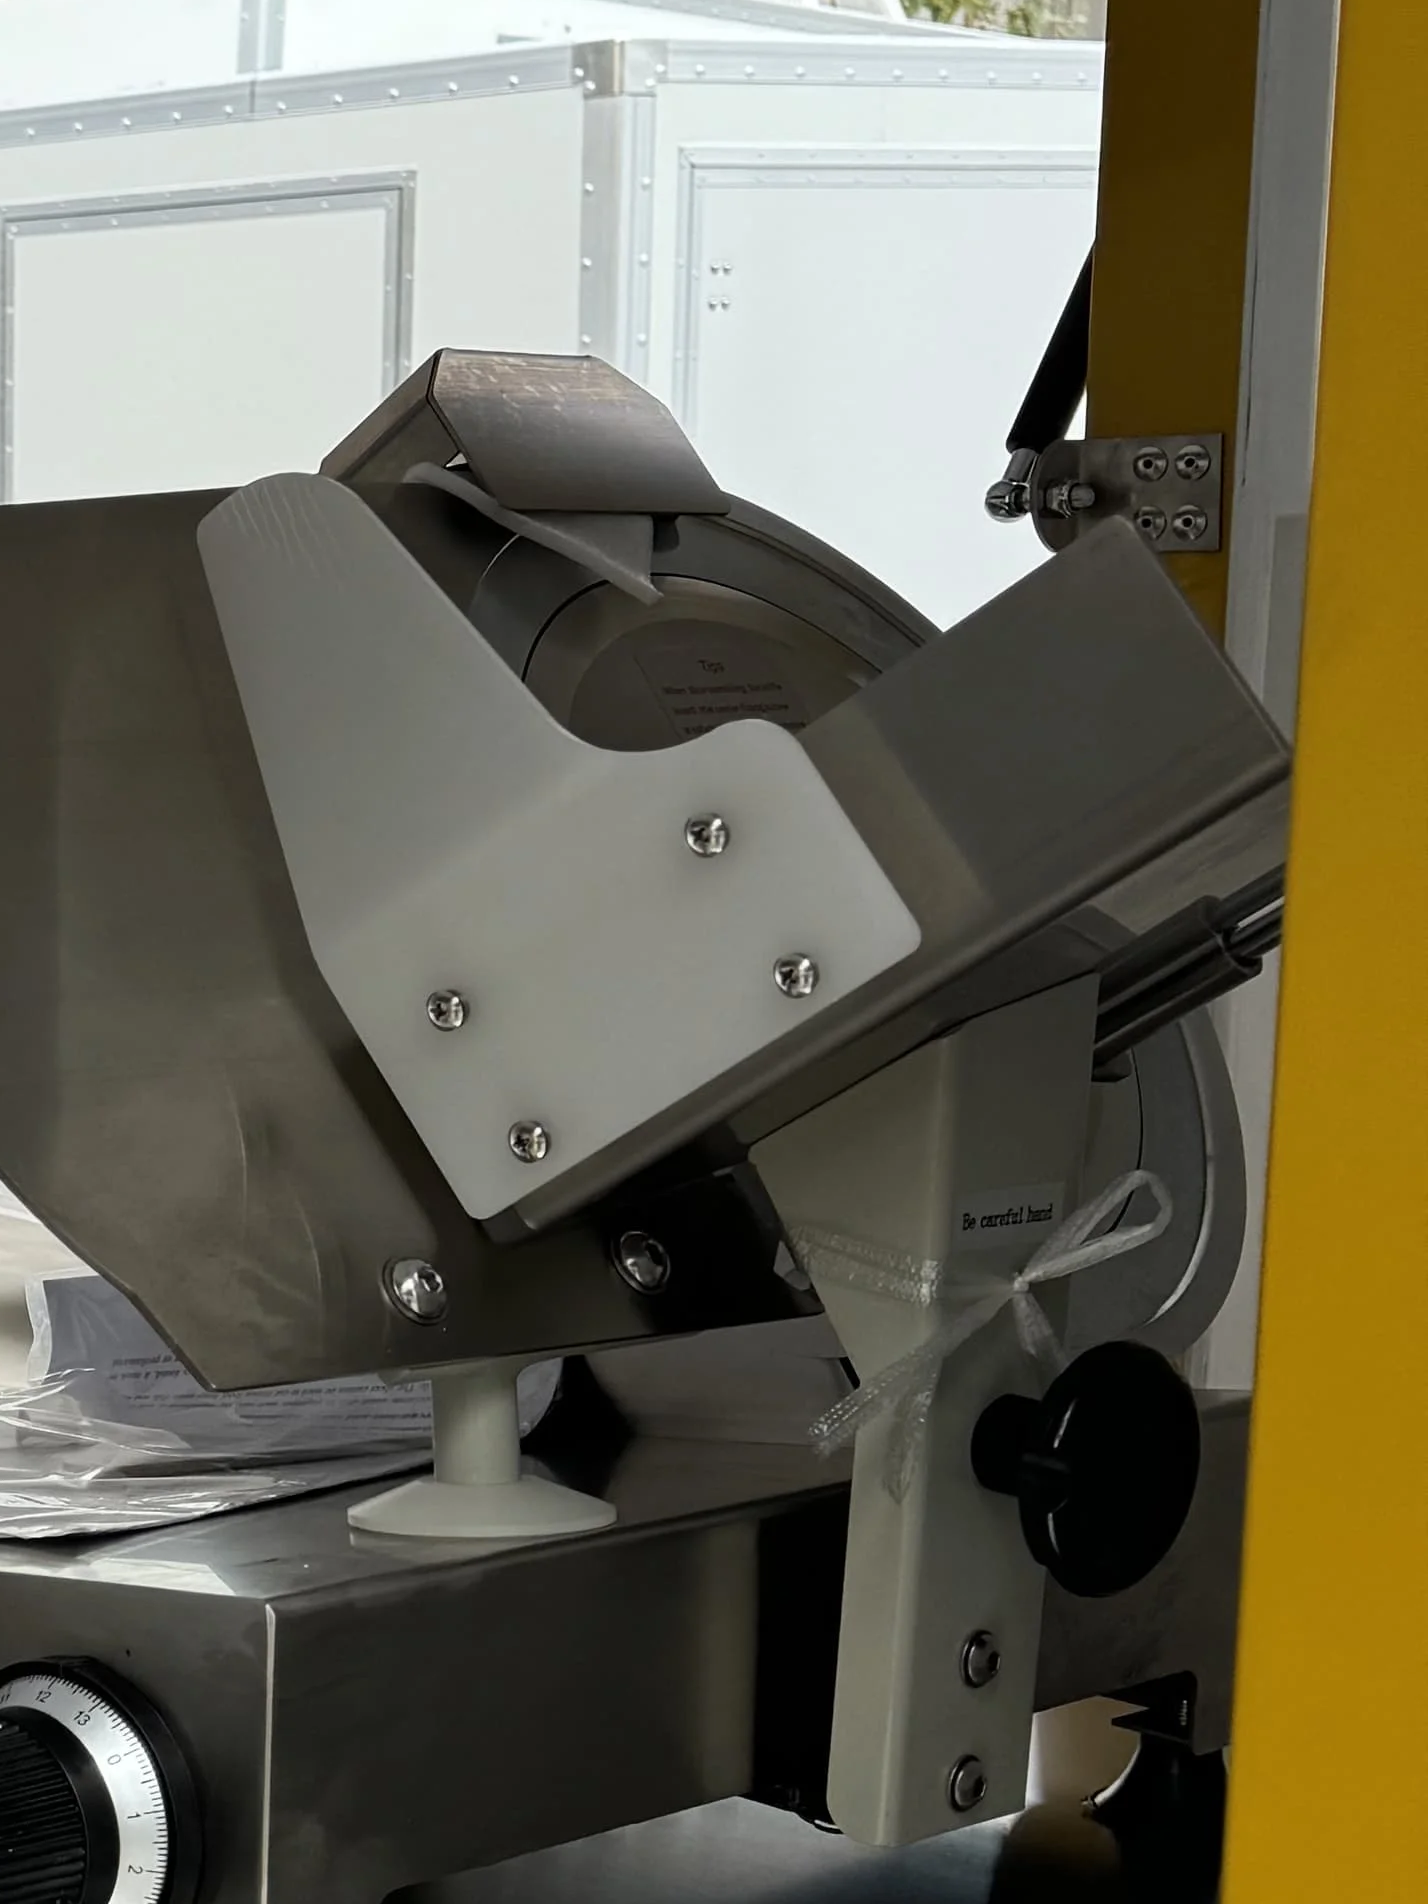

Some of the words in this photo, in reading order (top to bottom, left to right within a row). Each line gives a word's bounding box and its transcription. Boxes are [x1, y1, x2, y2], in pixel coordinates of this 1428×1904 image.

[962, 1213, 976, 1231] Be
[980, 1206, 1024, 1228] careful
[36, 1690, 52, 1704] 12
[73, 1710, 91, 1726] 13
[107, 1754, 122, 1766] 0
[127, 1864, 143, 1875] 2
